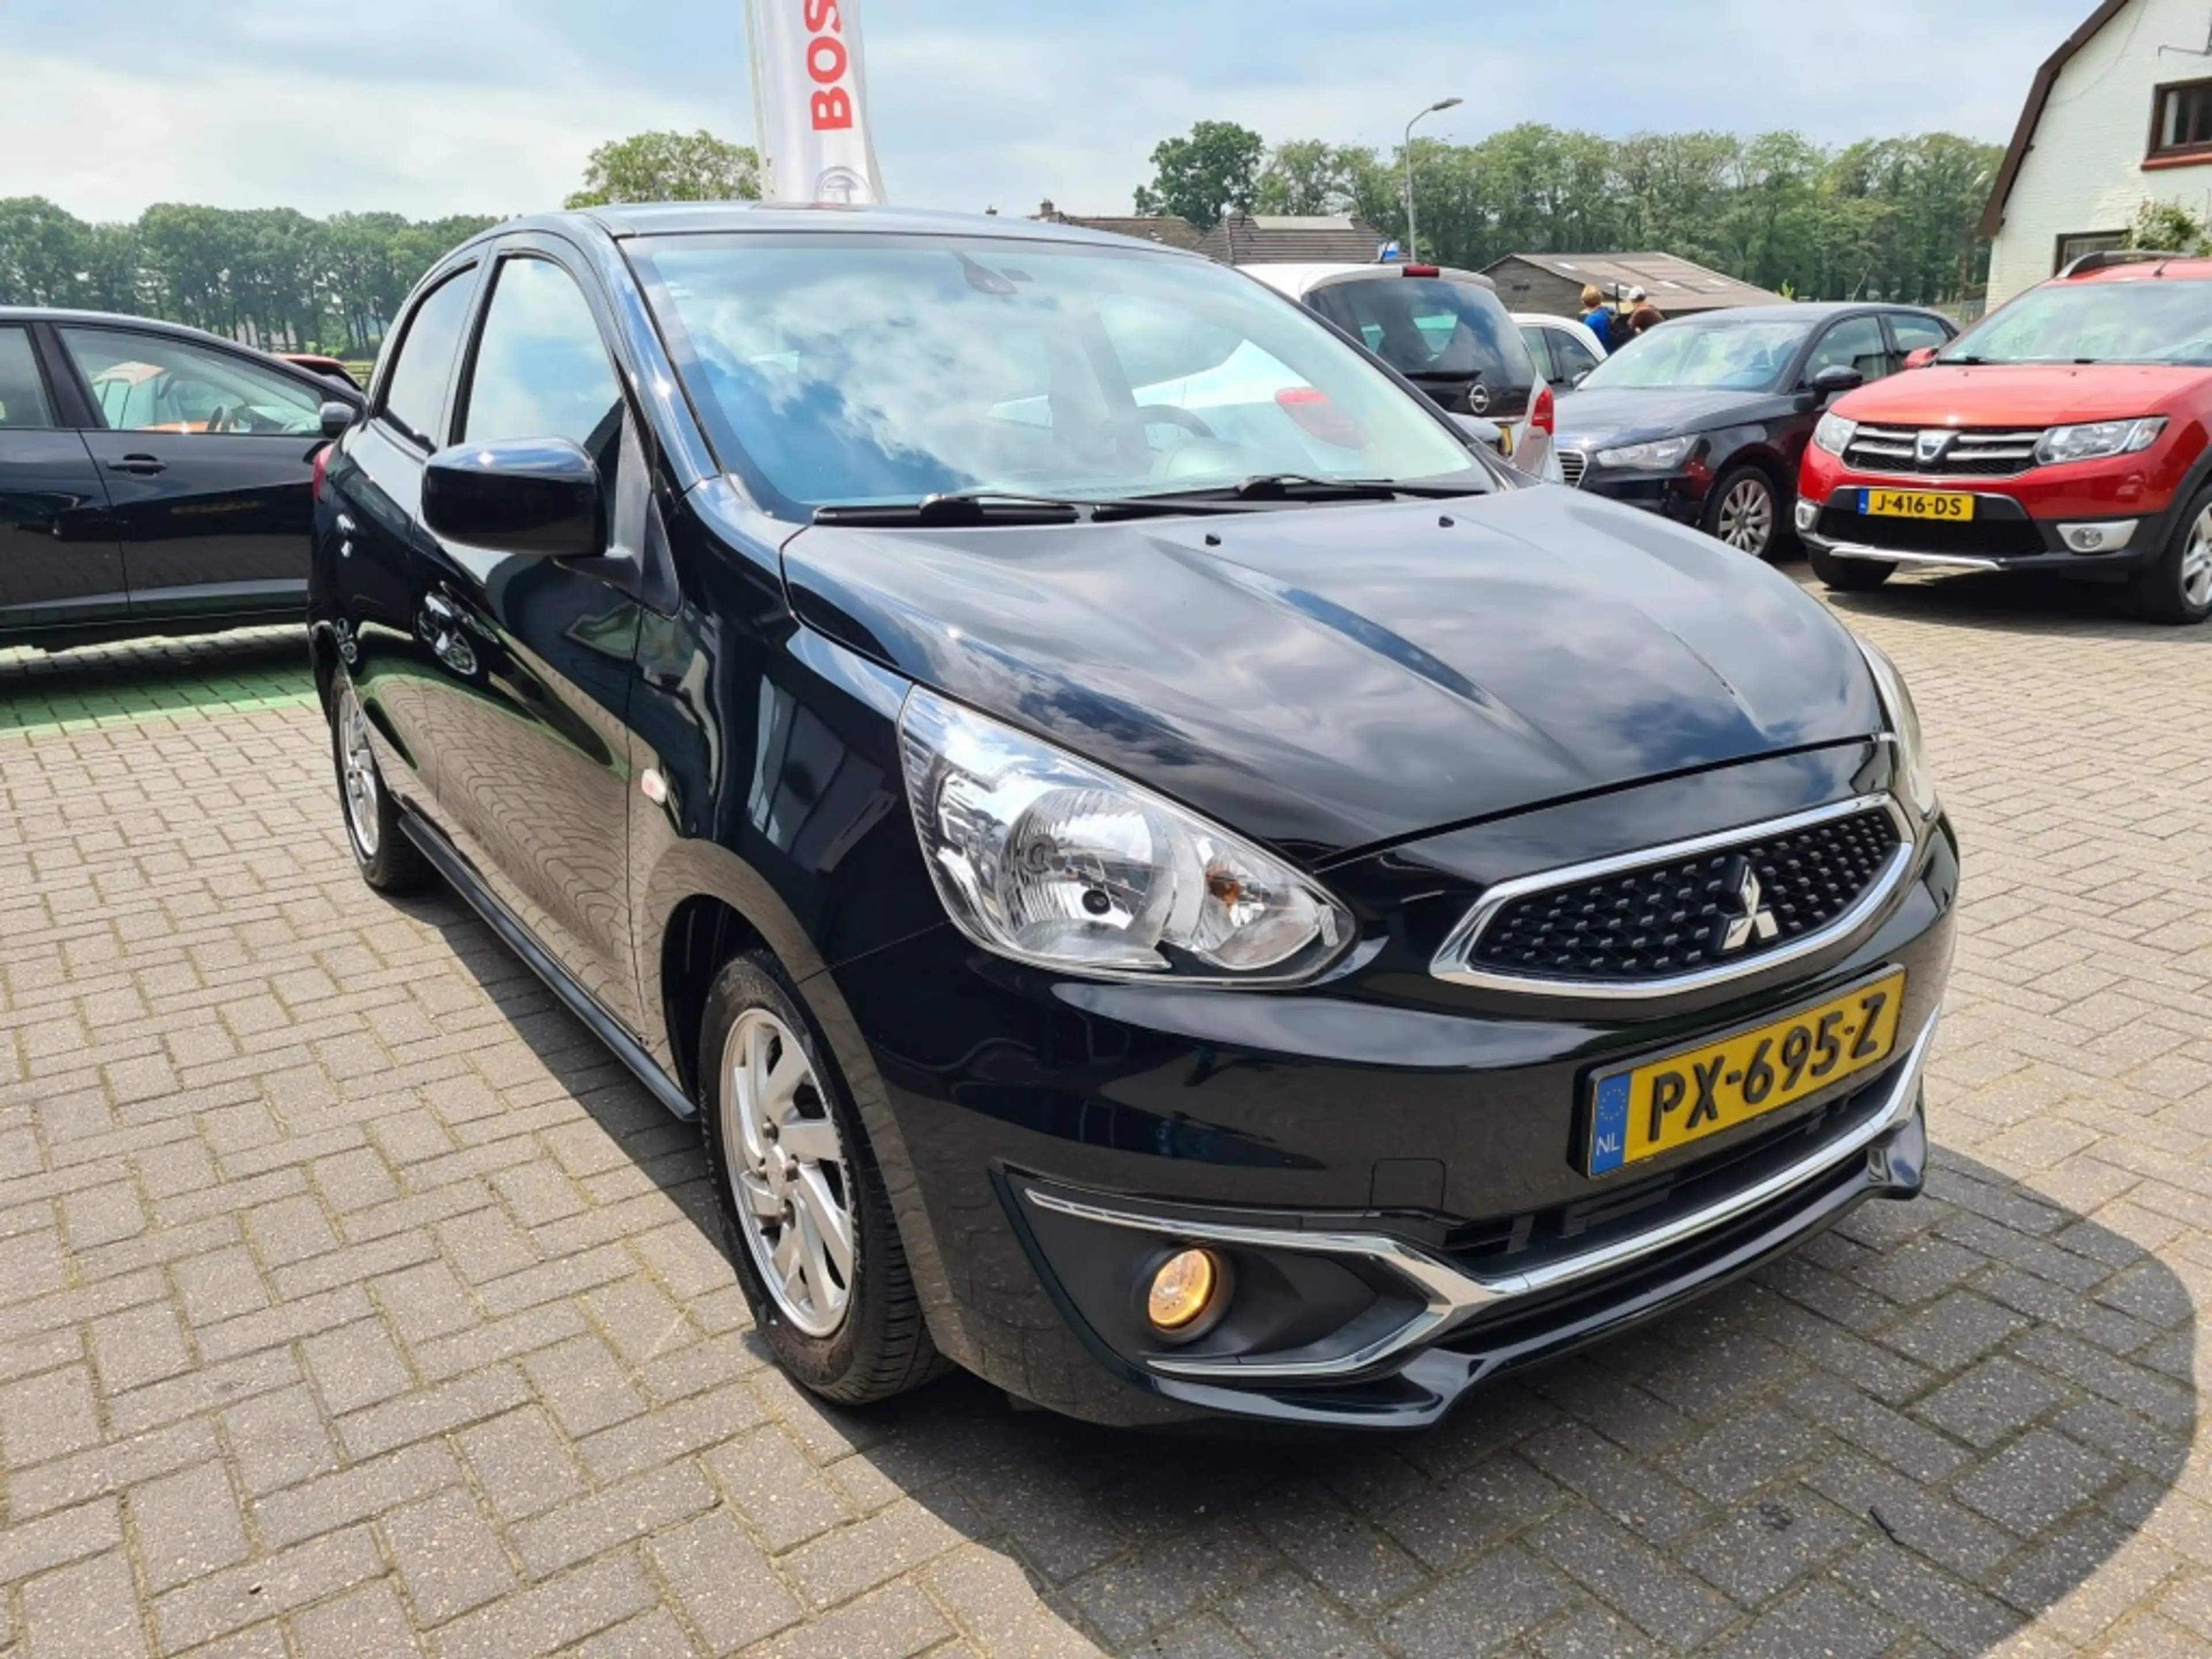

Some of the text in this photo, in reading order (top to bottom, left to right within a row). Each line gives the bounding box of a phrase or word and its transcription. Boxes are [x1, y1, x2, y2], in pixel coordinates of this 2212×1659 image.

[1877, 494, 1962, 516] J-416-DS
[1648, 991, 1887, 1142] PX-695-Z
[1596, 1133, 1620, 1156] NL
